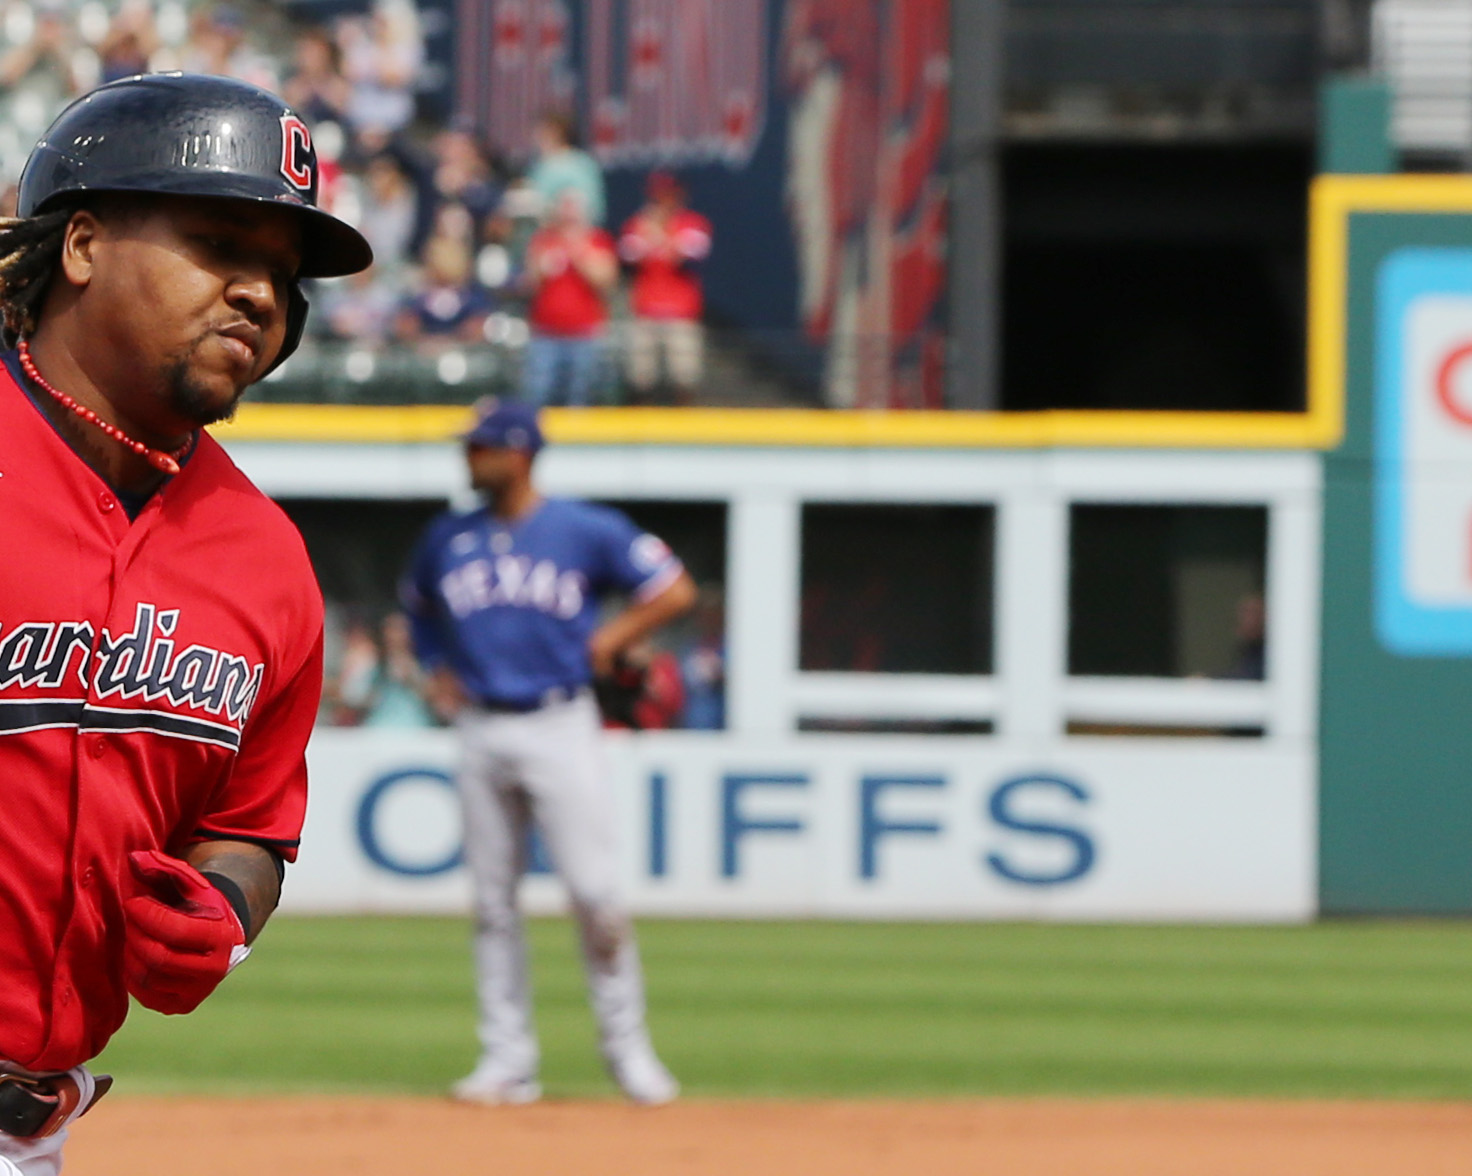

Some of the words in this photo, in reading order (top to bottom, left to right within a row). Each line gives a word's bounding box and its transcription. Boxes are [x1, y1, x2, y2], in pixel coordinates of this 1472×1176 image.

[280, 115, 312, 190] C
[439, 554, 588, 620] TEXAS
[356, 766, 1100, 888] CIFFS
